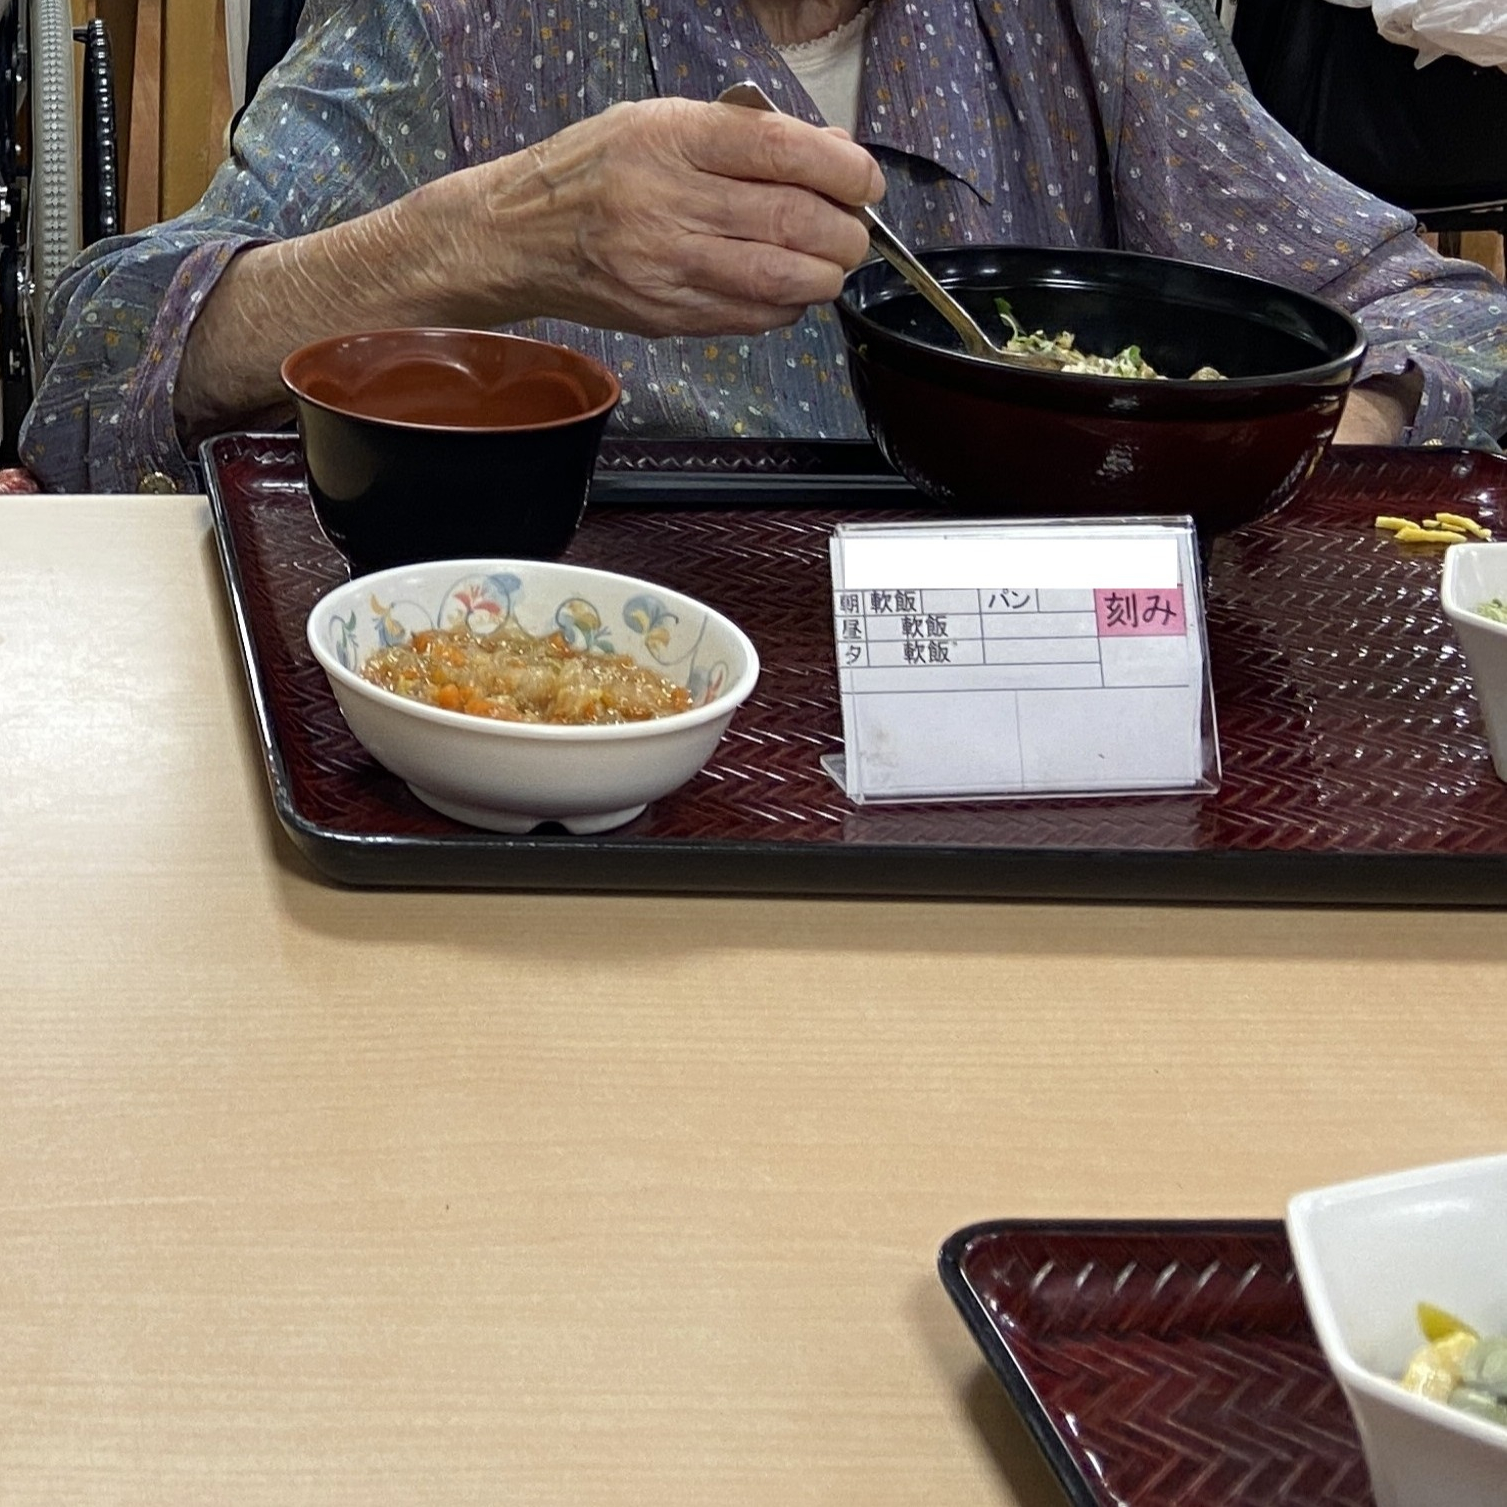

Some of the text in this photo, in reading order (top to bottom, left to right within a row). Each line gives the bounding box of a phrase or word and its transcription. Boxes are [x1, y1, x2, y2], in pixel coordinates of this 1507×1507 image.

[840, 589, 1177, 628] 朝 軟飯 パン 刻み
[841, 614, 950, 640] 昼 軟飯
[902, 640, 951, 665] 軟飯
